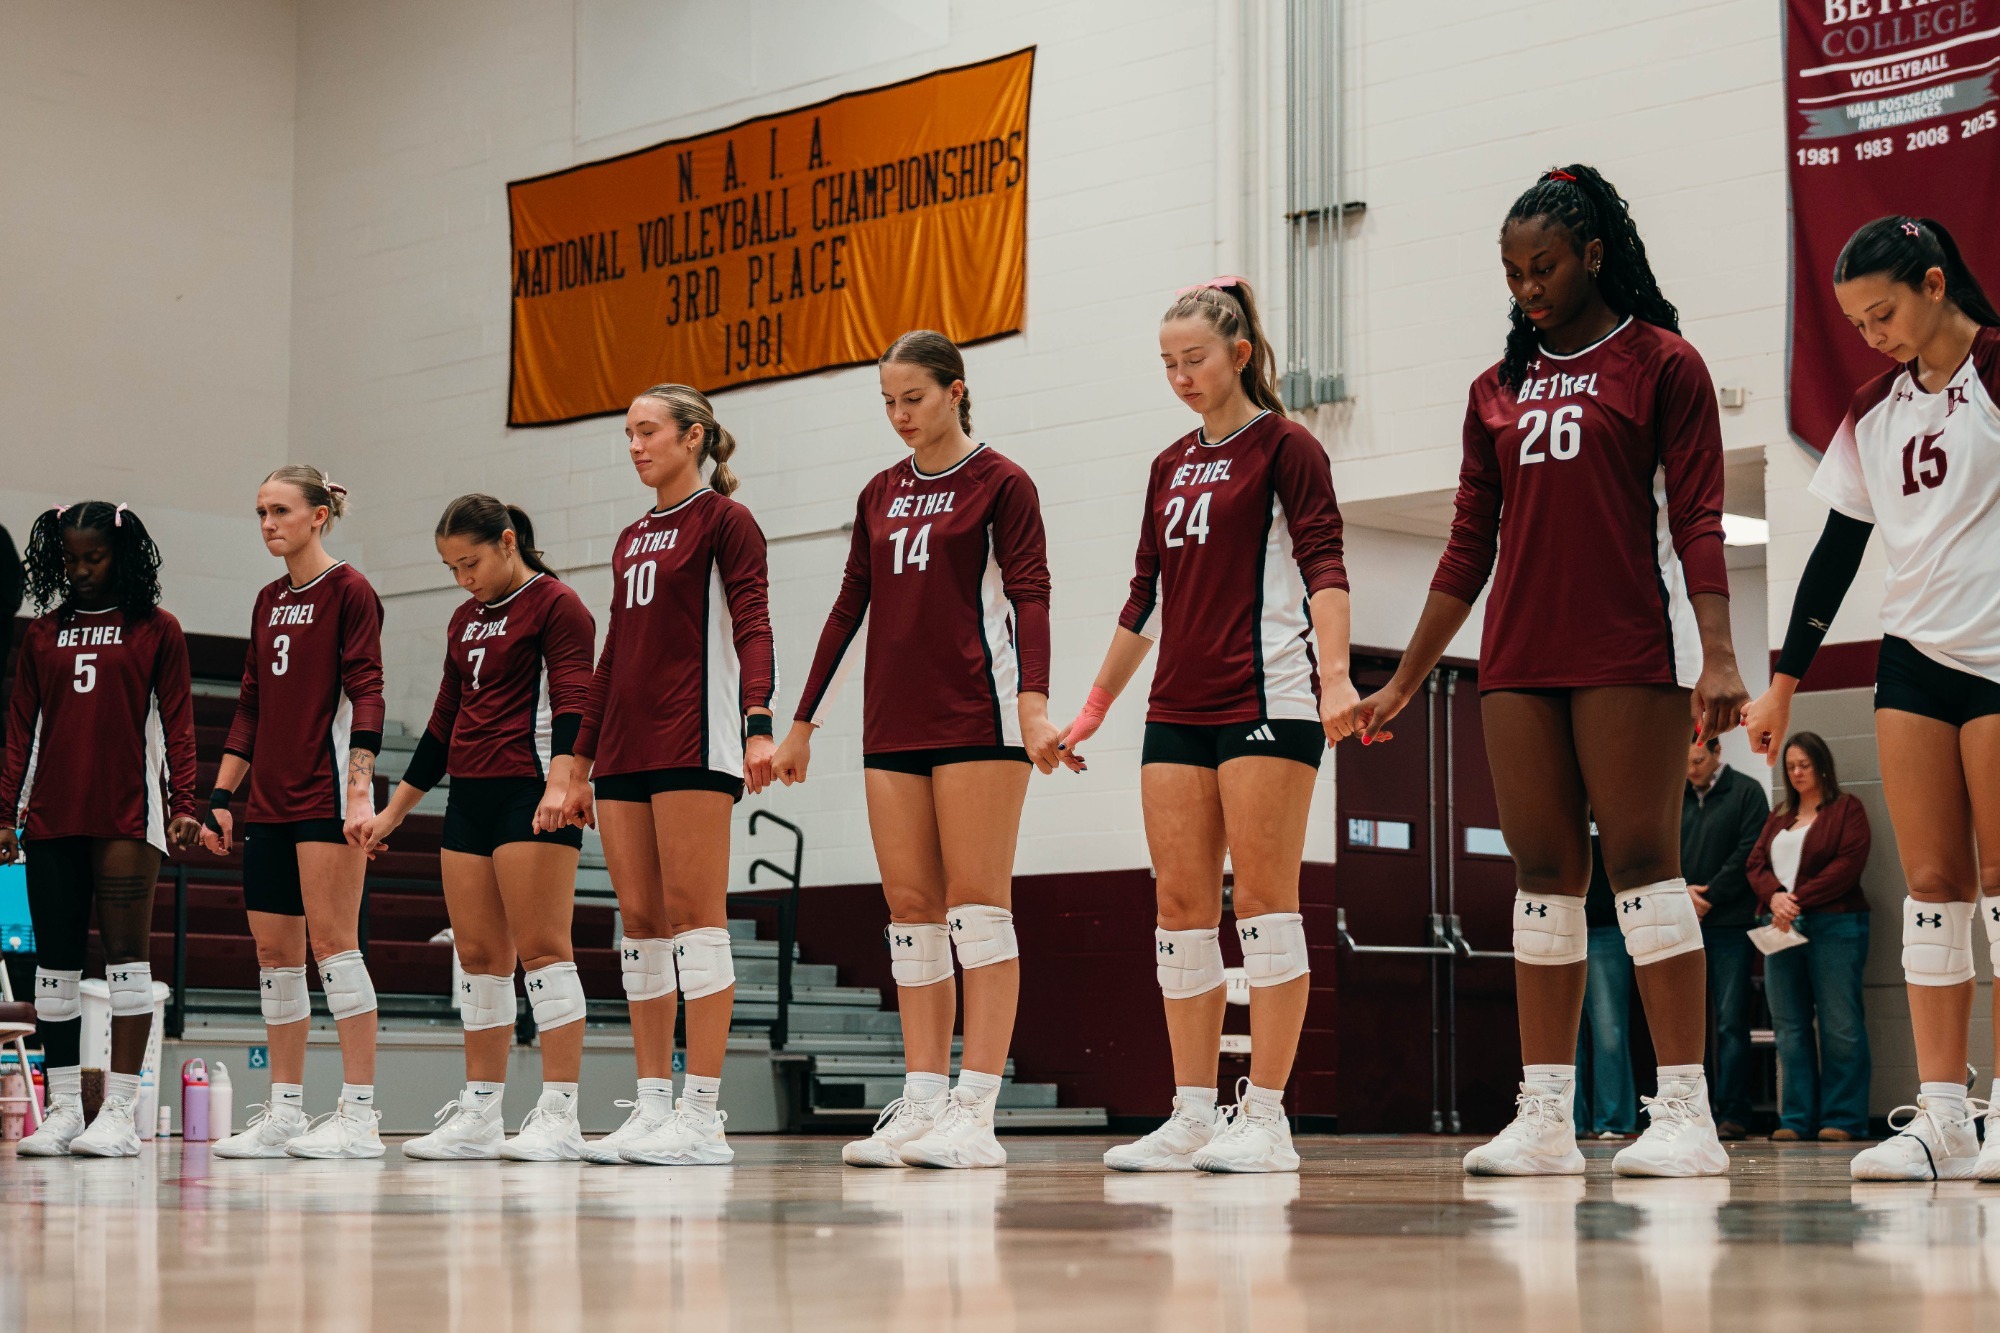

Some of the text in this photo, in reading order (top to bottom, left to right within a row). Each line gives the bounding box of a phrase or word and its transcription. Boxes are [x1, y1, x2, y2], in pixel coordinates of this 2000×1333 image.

[1821, 0, 1977, 57] COLLEGE
[1850, 53, 1949, 88] VOLLEYBALL
[1858, 100, 1943, 131] APPEARANCES
[1878, 83, 1955, 113] POSTSEASON
[677, 150, 700, 203] N.
[723, 138, 747, 192] A.
[807, 116, 831, 171] A.
[1796, 109, 1998, 167] 1981 1983 2008 2025
[513, 130, 1022, 299] NATIONAL VOLLEYBALL CHAMPIONSHIPS
[666, 235, 847, 327] 3RD PLACE
[724, 313, 784, 376] 1981
[1516, 372, 1599, 405] BETHEL
[1517, 405, 1583, 466] 26
[1901, 427, 1948, 497] 15
[886, 491, 956, 518] BETHEL
[1164, 491, 1213, 549] 24
[888, 523, 933, 575] 14
[623, 560, 657, 609] 10
[56, 626, 123, 648] BETHEL
[271, 634, 291, 676] 3
[73, 653, 98, 694] 5
[467, 647, 486, 690] 7
